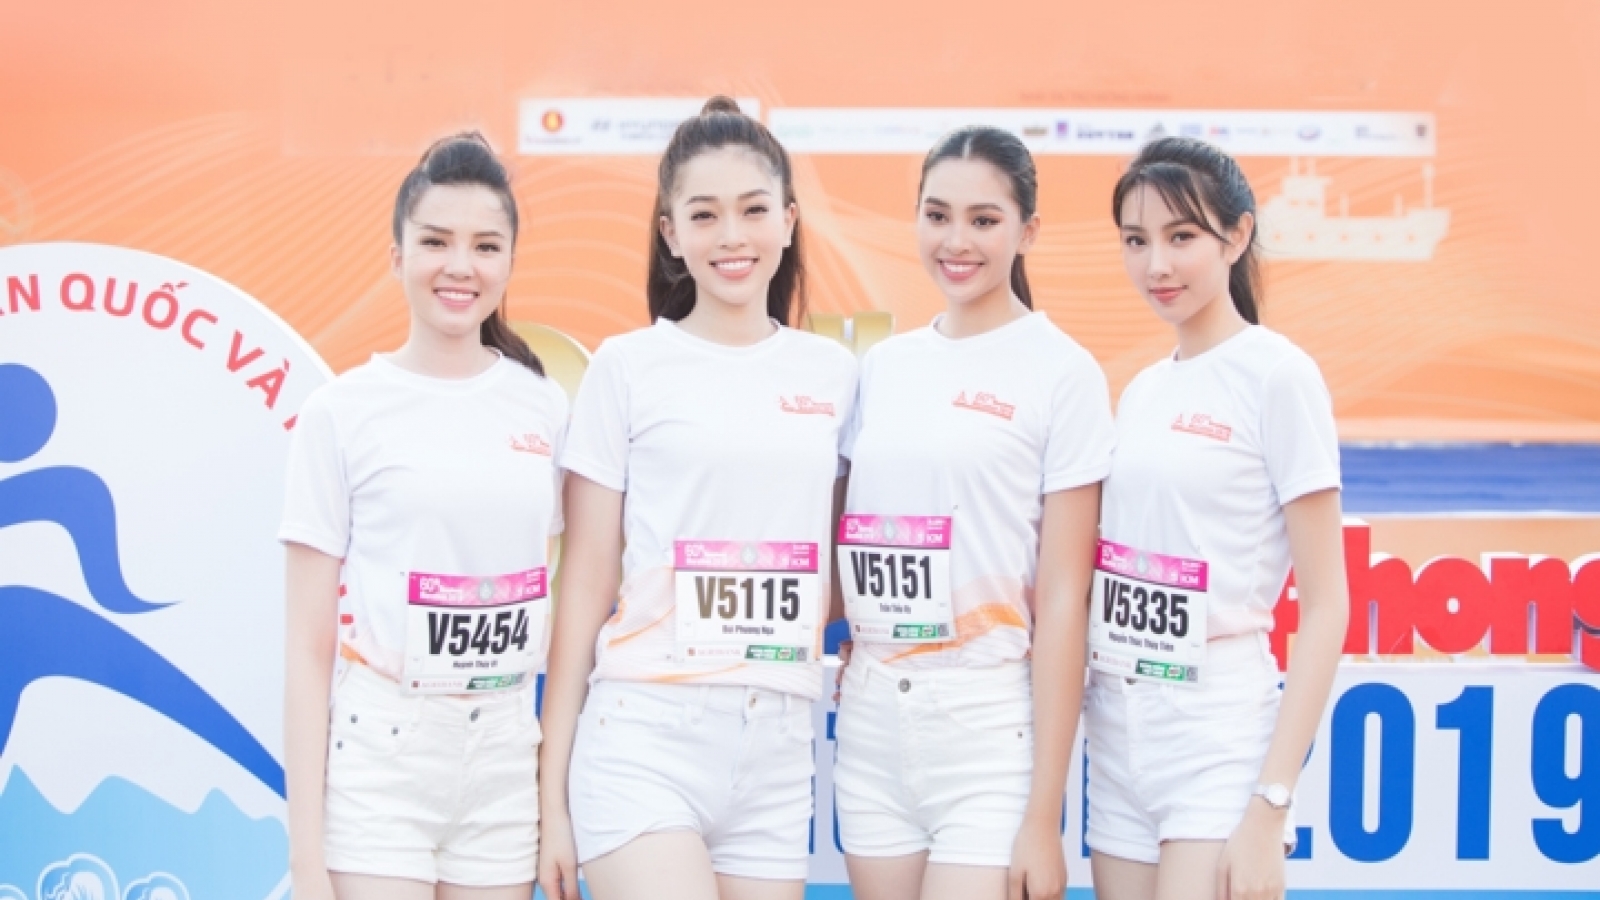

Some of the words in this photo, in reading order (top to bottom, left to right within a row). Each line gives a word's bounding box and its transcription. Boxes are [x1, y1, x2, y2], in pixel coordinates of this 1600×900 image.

[60, 272, 218, 350] QUỐC
[226, 329, 290, 410] VÀ
[694, 575, 800, 622] V5115
[850, 551, 932, 600] V5151
[427, 606, 529, 656] V5454
[1103, 577, 1189, 639] V5335
[1280, 682, 1600, 864] 019
